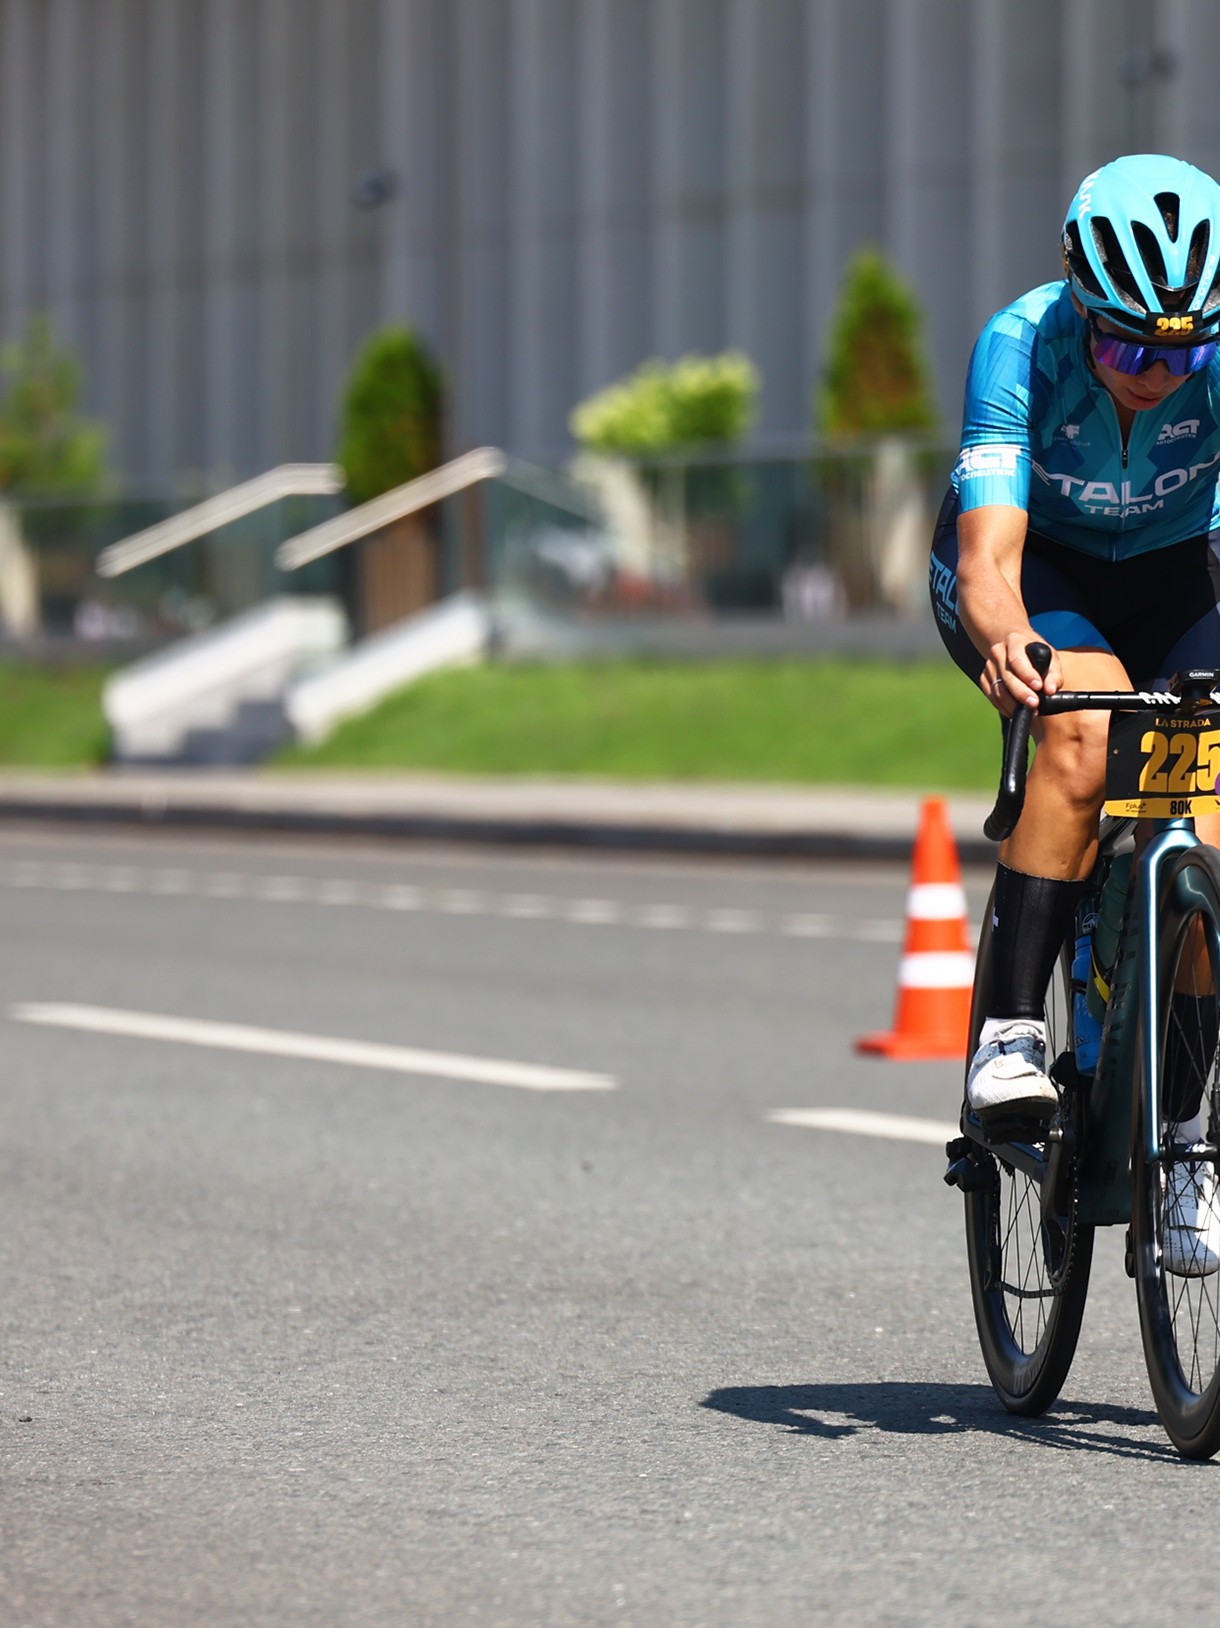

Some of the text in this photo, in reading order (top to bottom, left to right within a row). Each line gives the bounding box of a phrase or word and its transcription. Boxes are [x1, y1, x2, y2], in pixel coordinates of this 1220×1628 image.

[1154, 316, 1194, 337] 225
[1031, 450, 1220, 506] ETALON
[1084, 499, 1165, 520] TEAM
[936, 601, 958, 634] TEAM
[1155, 717, 1212, 729] LA STRADA
[1170, 800, 1193, 816] 80K
